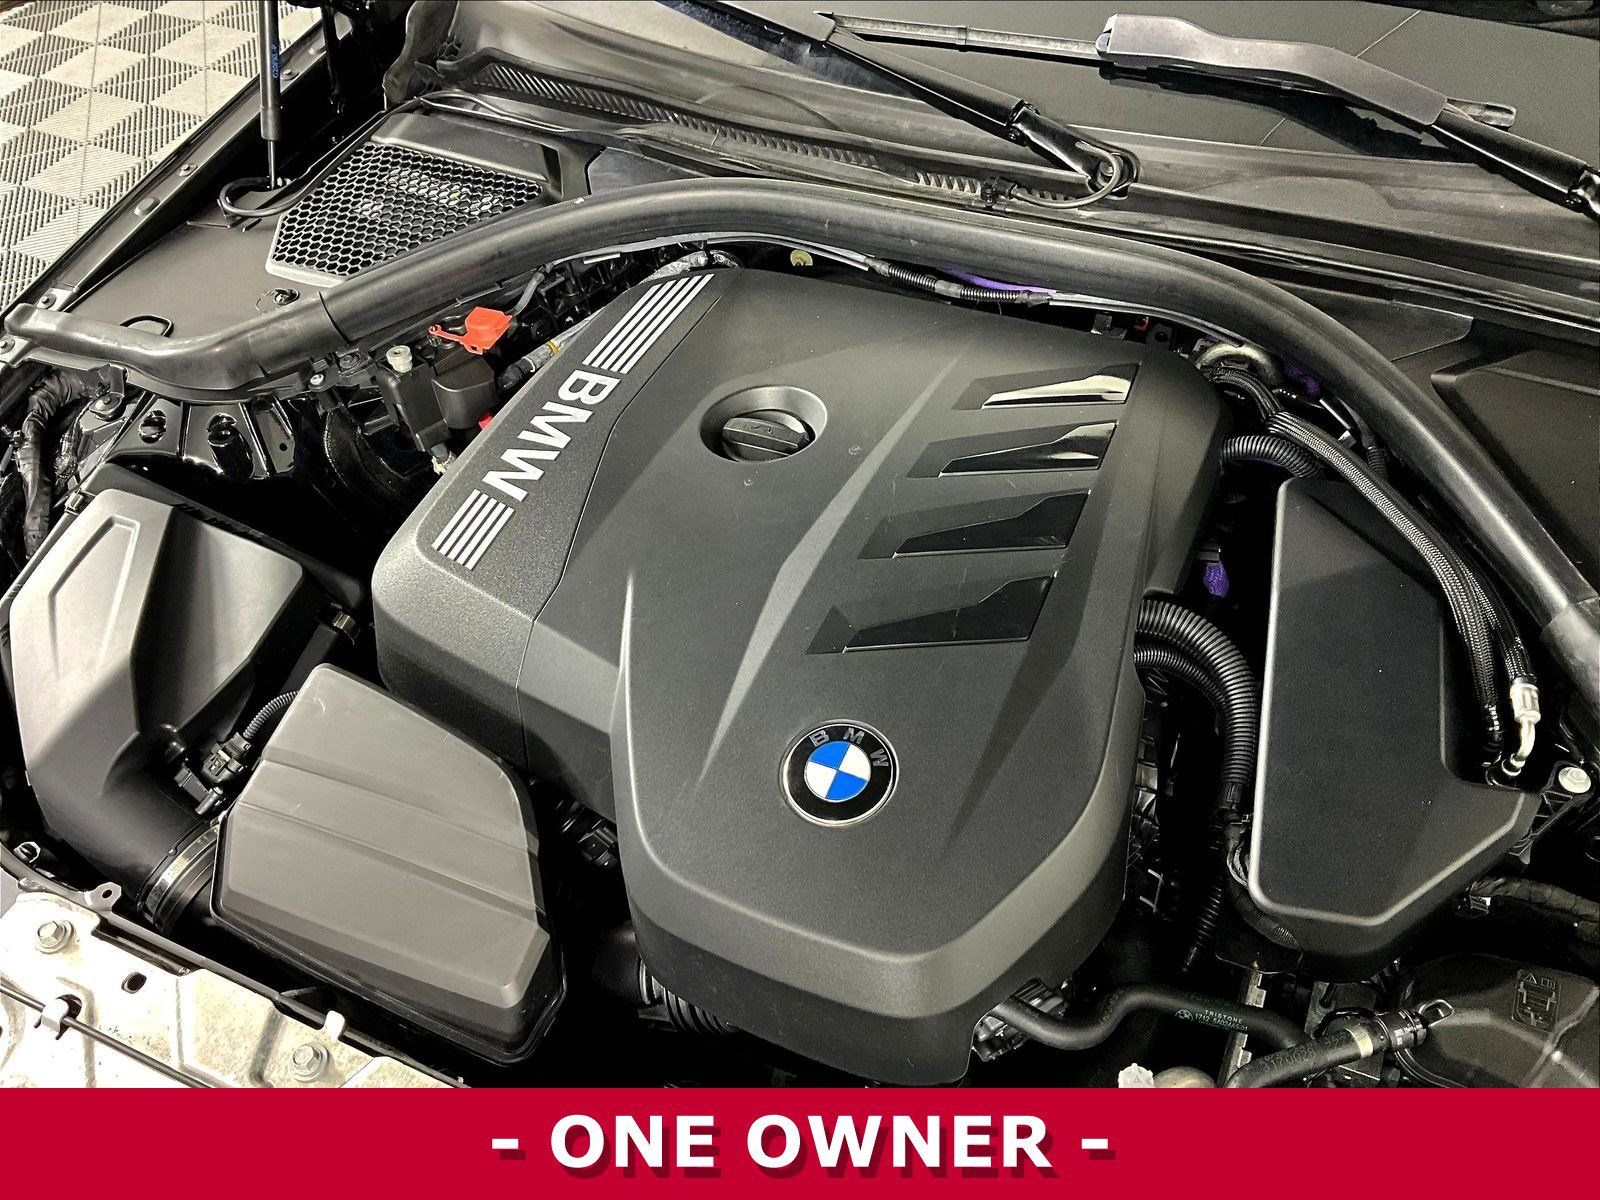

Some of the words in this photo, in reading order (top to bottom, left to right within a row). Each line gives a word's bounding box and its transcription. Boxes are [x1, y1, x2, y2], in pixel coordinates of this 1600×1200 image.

[482, 369, 621, 502] BMW
[808, 726, 890, 767] BMW
[1204, 1009, 1243, 1024] TRISTONE
